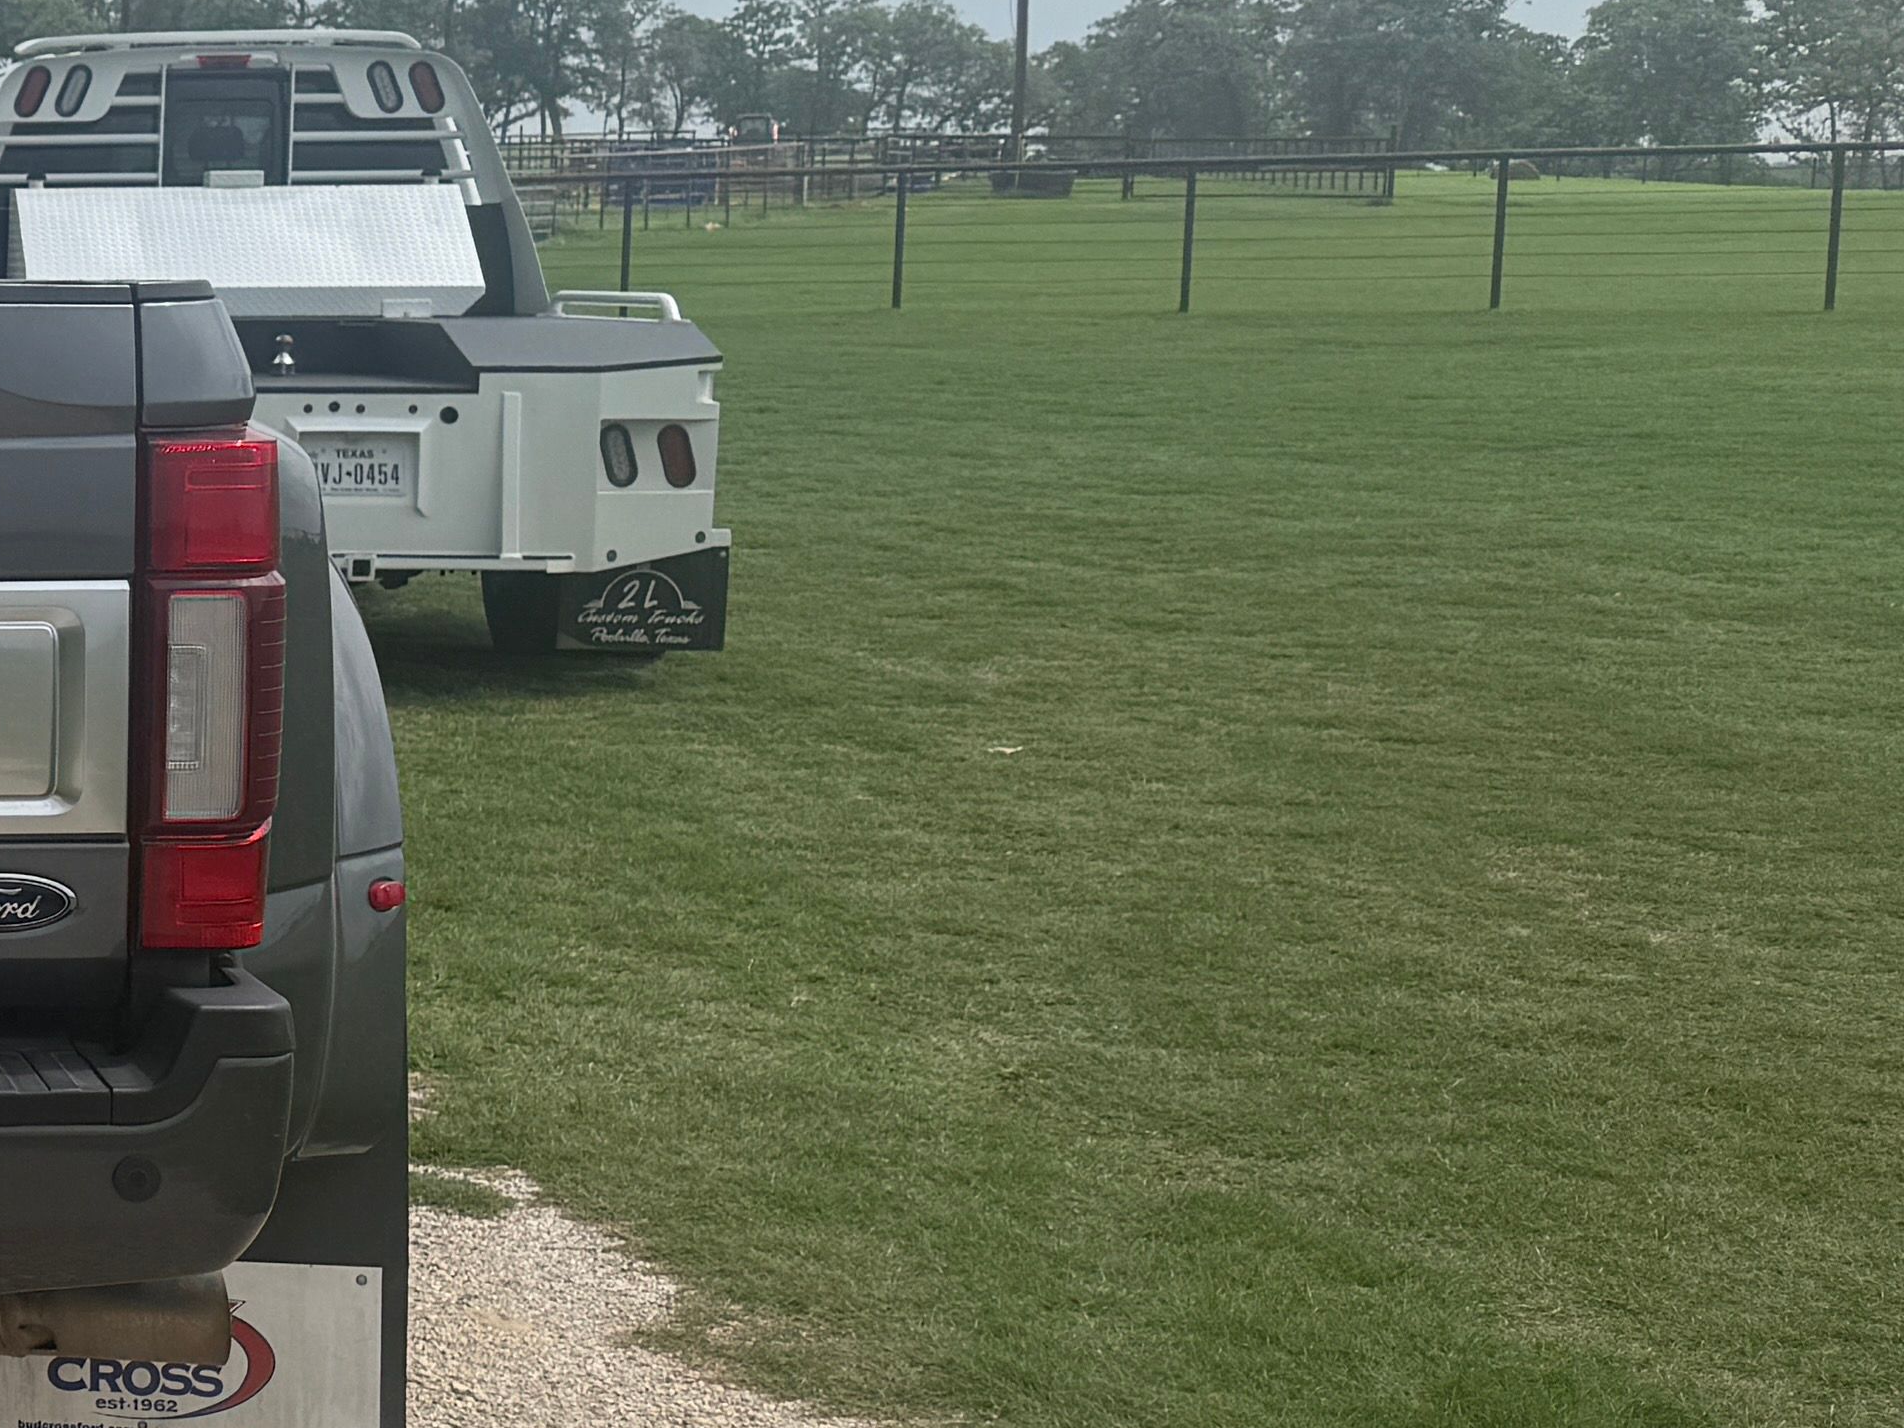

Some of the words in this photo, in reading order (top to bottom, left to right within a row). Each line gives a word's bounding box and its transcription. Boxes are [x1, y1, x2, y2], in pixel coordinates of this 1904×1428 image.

[336, 449, 374, 459] TEXAS
[577, 609, 639, 624] Custom
[647, 609, 705, 624] Trucks
[47, 1356, 224, 1398] CROSS
